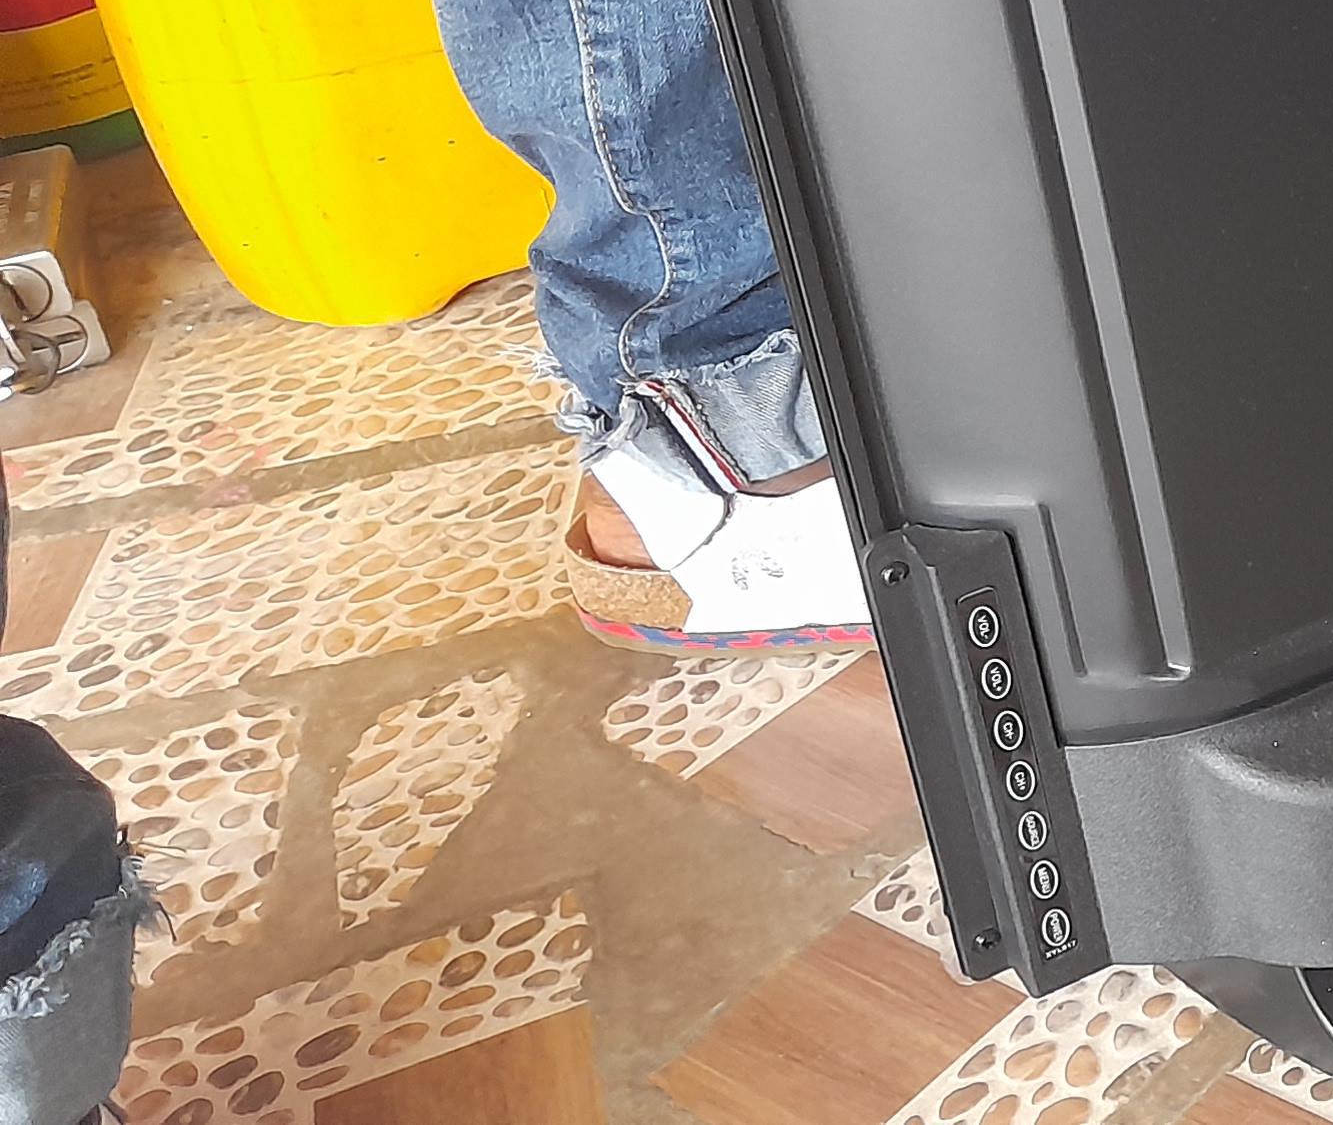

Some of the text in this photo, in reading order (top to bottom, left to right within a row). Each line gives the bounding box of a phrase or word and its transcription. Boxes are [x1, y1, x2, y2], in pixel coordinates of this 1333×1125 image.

[977, 614, 991, 640] VOL-
[990, 666, 1003, 692] VOL+
[1037, 866, 1051, 894] MENU
[1049, 912, 1064, 943] POWER
